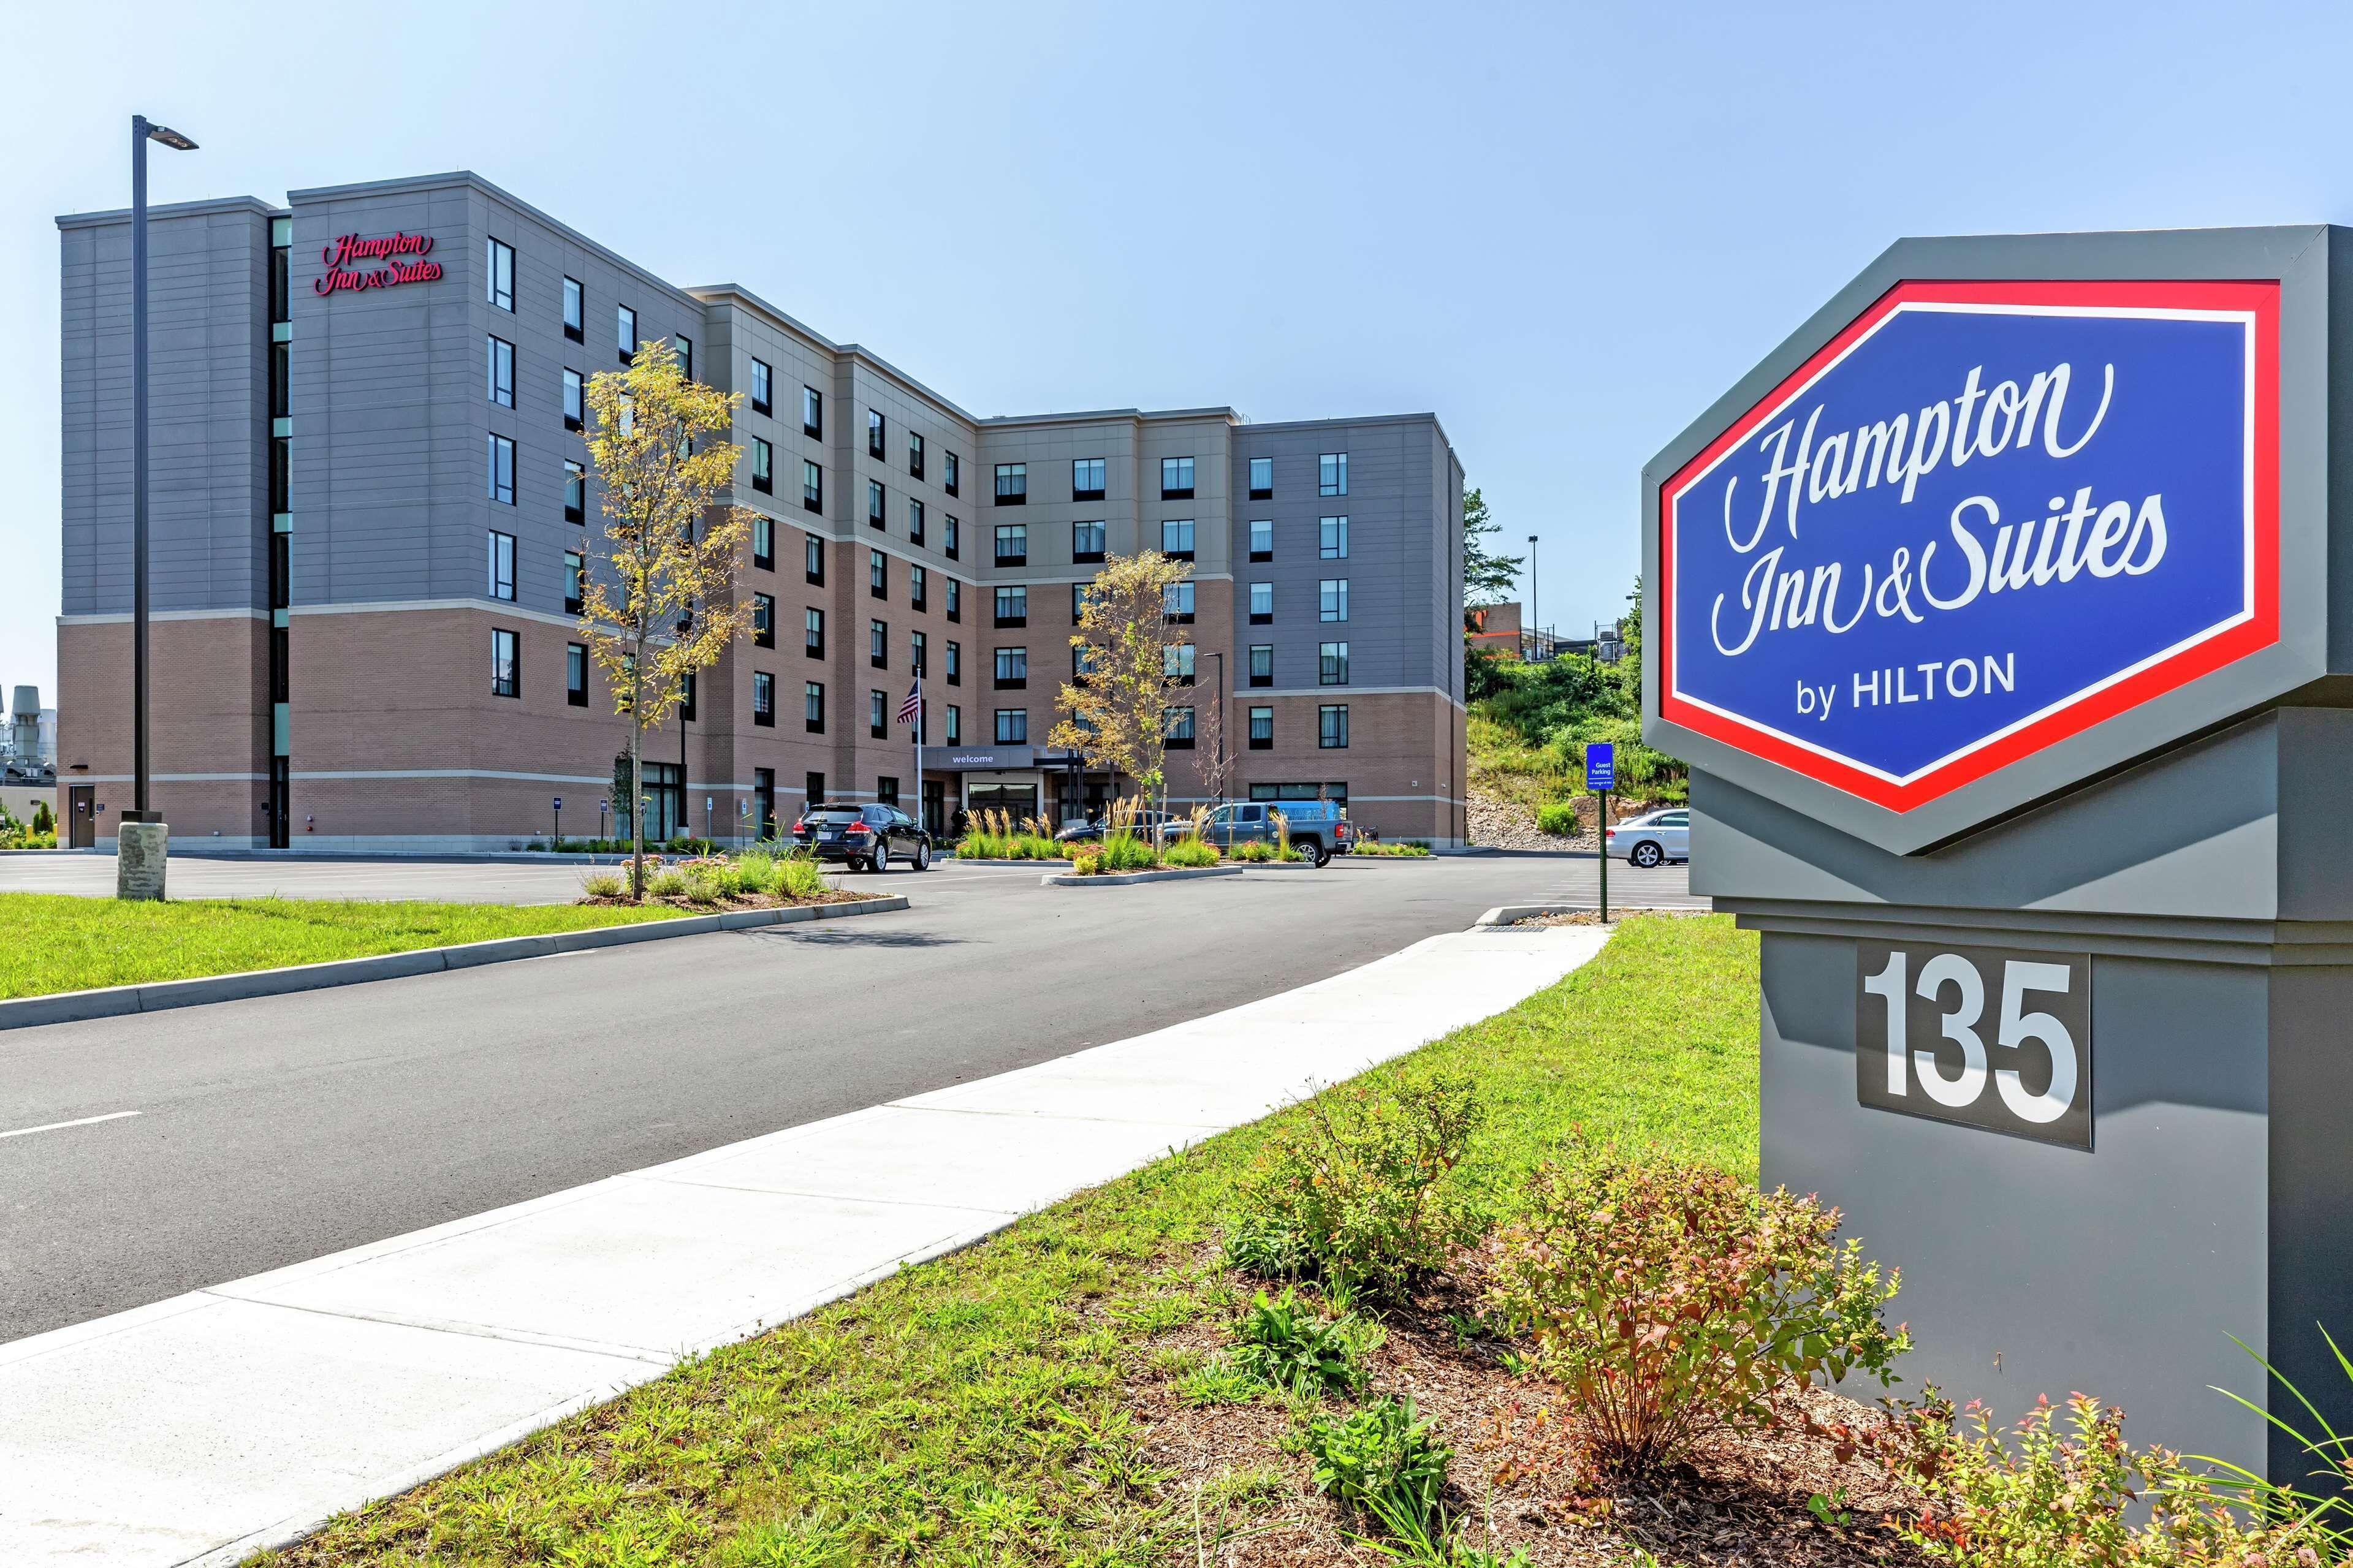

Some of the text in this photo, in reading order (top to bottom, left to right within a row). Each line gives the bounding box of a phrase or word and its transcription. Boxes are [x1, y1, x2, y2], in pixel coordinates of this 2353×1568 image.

[314, 259, 441, 296] Inn & Suites
[321, 231, 433, 267] Hampton
[1724, 363, 2114, 553] Hampton
[1712, 486, 2167, 656] Inn & Suites
[1796, 653, 2015, 721] by HILTON
[1865, 951, 2078, 1124] 135
